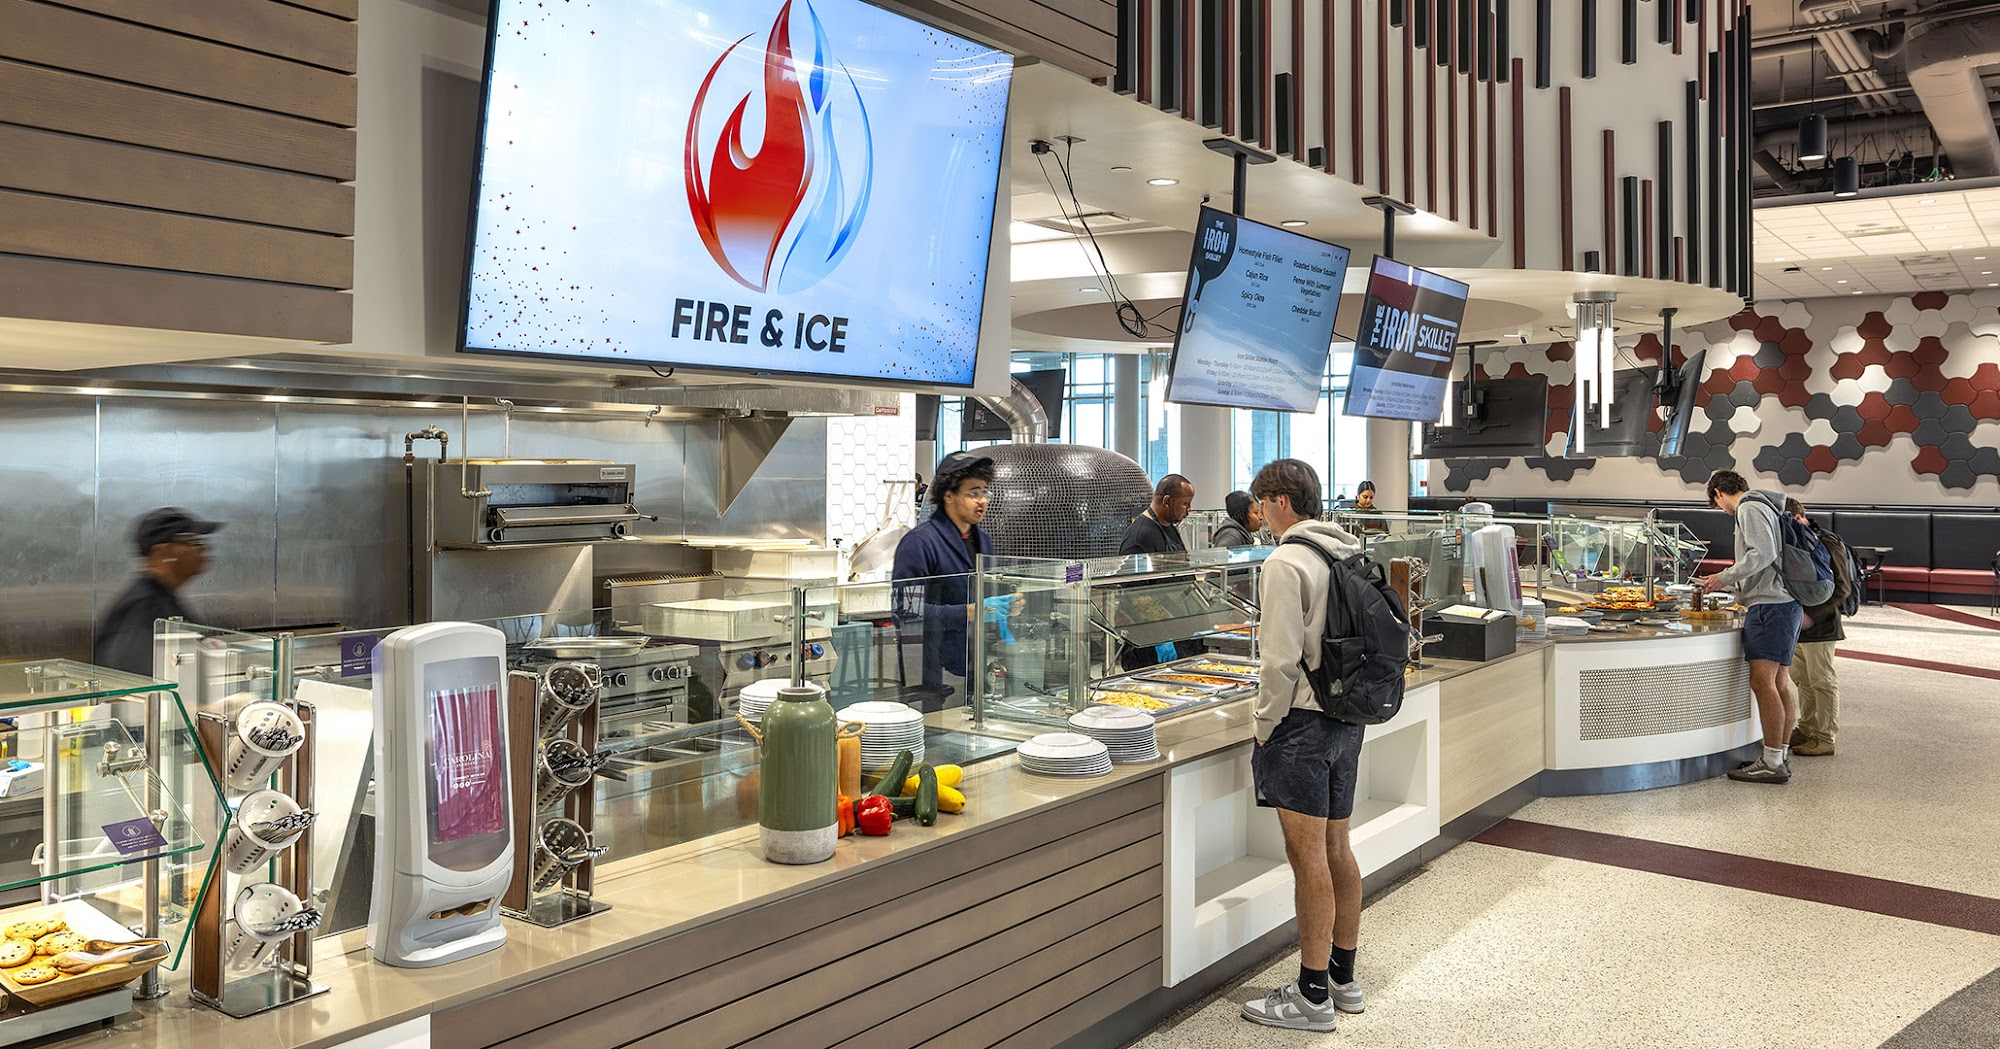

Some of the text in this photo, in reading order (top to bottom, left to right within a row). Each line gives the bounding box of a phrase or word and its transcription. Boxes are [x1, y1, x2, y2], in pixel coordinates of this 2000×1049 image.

[1204, 228, 1229, 254] IRON
[1238, 246, 1283, 264] Homestyle Fish Fillet
[1245, 270, 1269, 281] Cajun Rice
[1293, 260, 1337, 278] Roasted Yellow Squash
[1293, 276, 1331, 291] Penne With Summer
[1241, 290, 1265, 302] Spicy Okra
[1300, 287, 1321, 297] Vegetables
[1291, 305, 1321, 317] Cheddar Biscuit
[671, 298, 849, 353] FIRE & ICE
[1370, 305, 1456, 353] THE IRON SKILLET
[444, 752, 490, 765] CAROLINA
